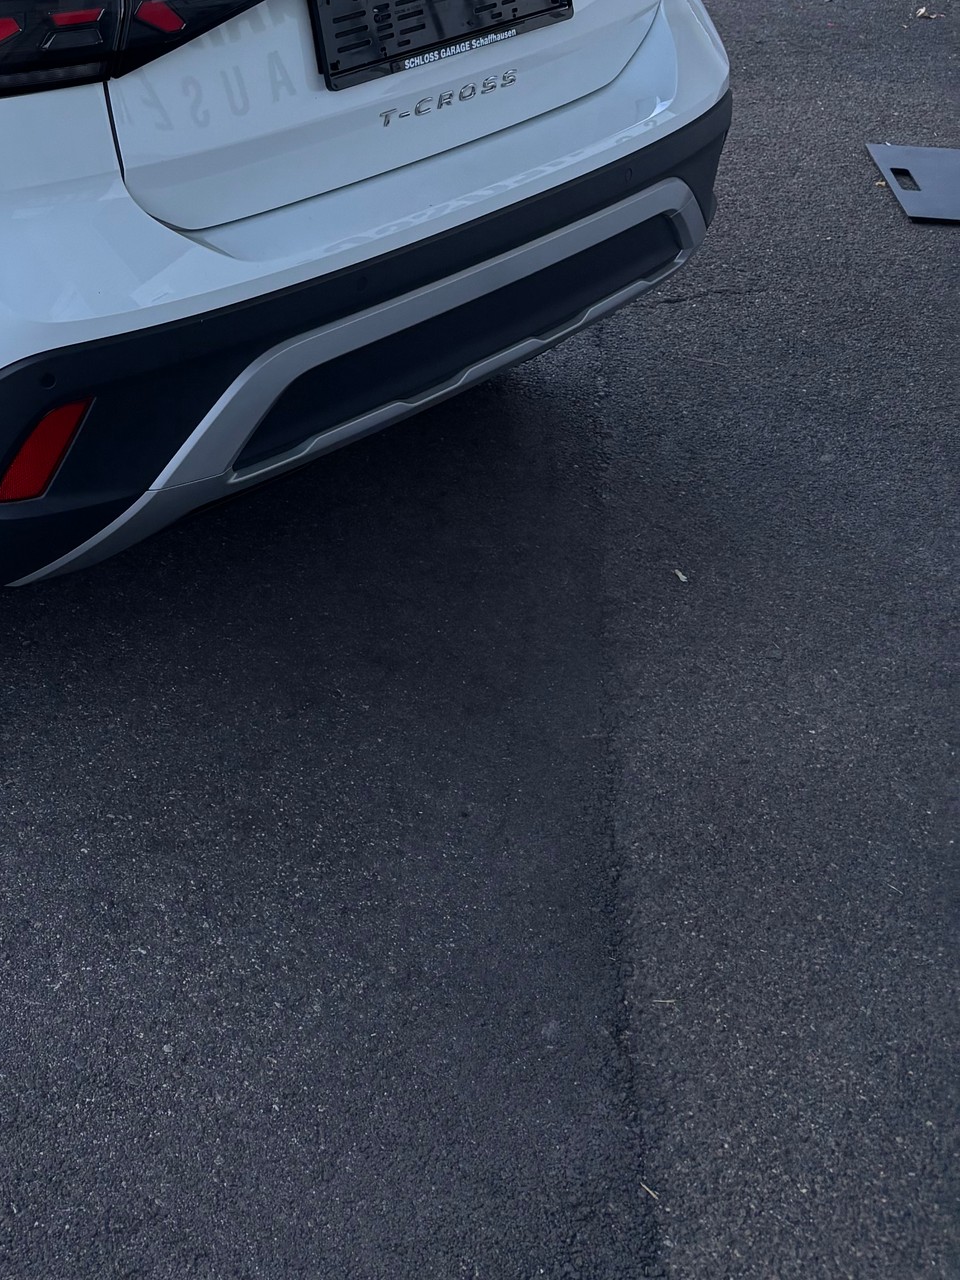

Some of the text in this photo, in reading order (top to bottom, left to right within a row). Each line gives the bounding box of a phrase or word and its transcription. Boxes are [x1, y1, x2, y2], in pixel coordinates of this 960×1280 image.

[404, 28, 517, 69] SCHLOSS GARAGE Schaffhausen
[379, 69, 518, 127] T-CROSS
